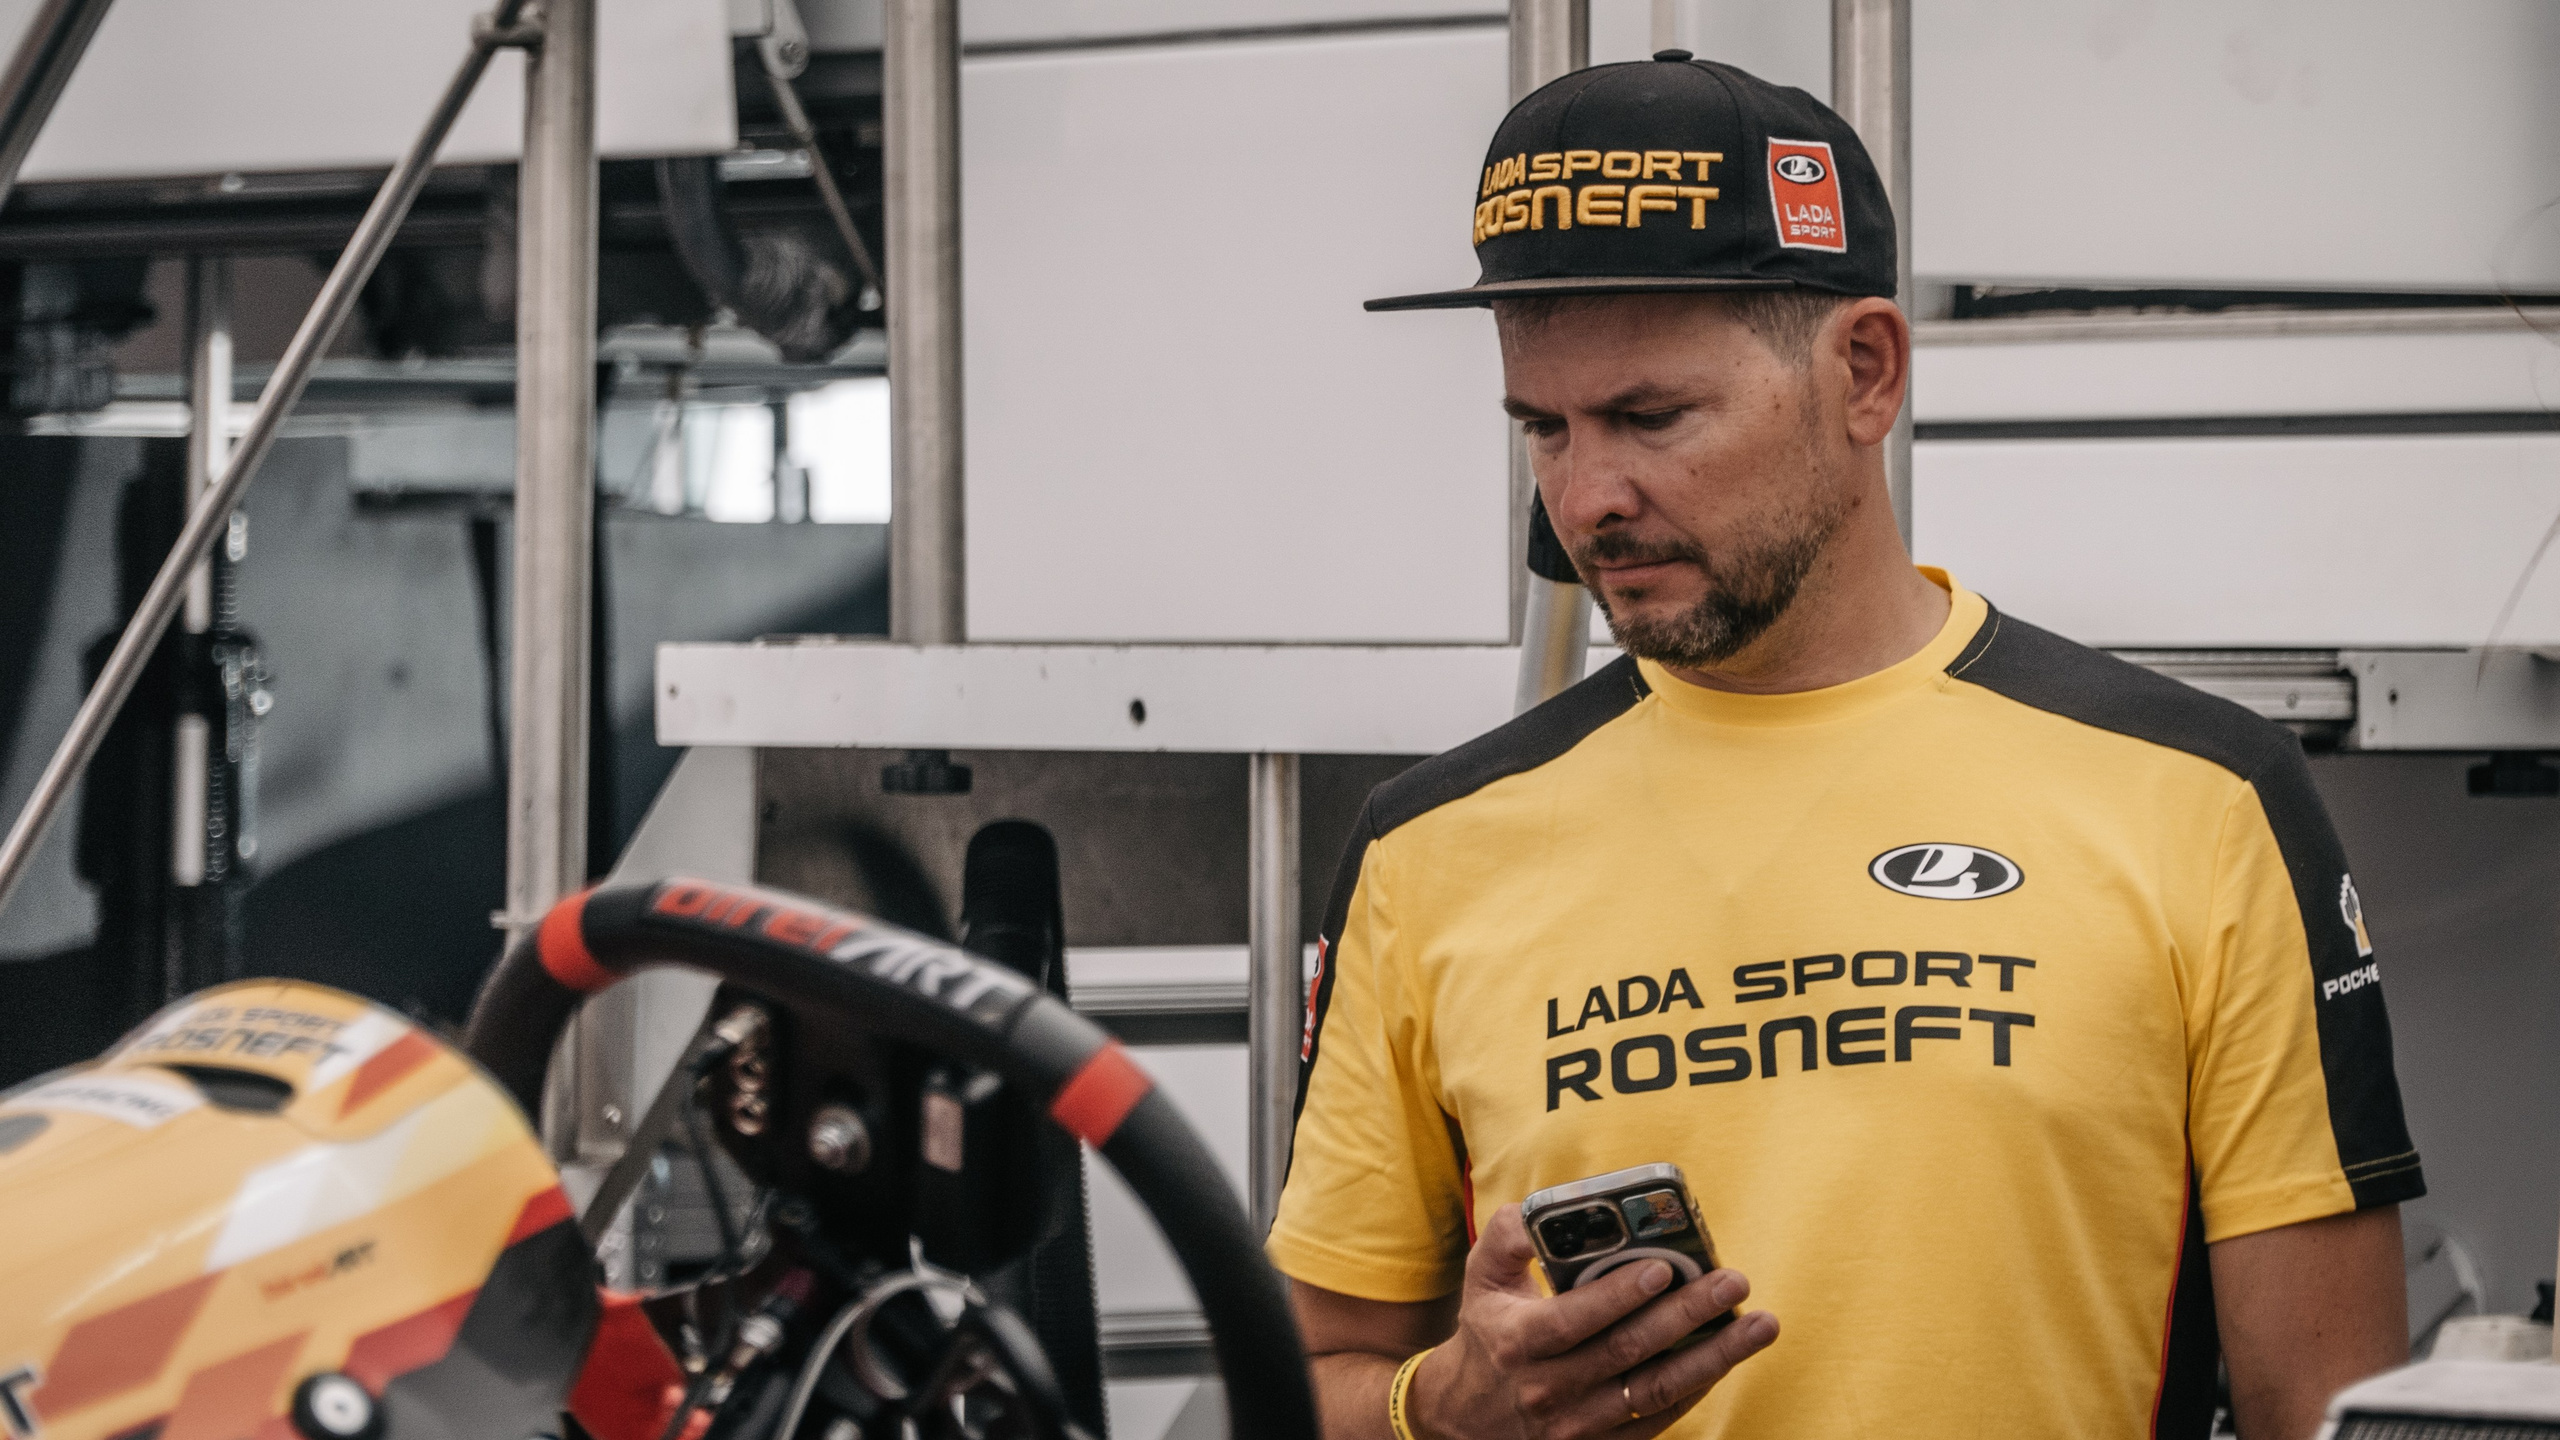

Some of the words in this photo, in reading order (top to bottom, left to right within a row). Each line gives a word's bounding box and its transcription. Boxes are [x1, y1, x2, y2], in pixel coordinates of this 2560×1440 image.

[1481, 153, 1526, 199] LADA
[1528, 150, 1723, 182] SPORT
[1473, 185, 1720, 248] ROSNEFT
[1785, 203, 1836, 226] LADA
[1790, 224, 1837, 240] SPORT
[1546, 967, 1706, 1040] LADA
[1732, 950, 2037, 1004] SPORT
[1546, 1005, 2036, 1113] ROSNEFT
